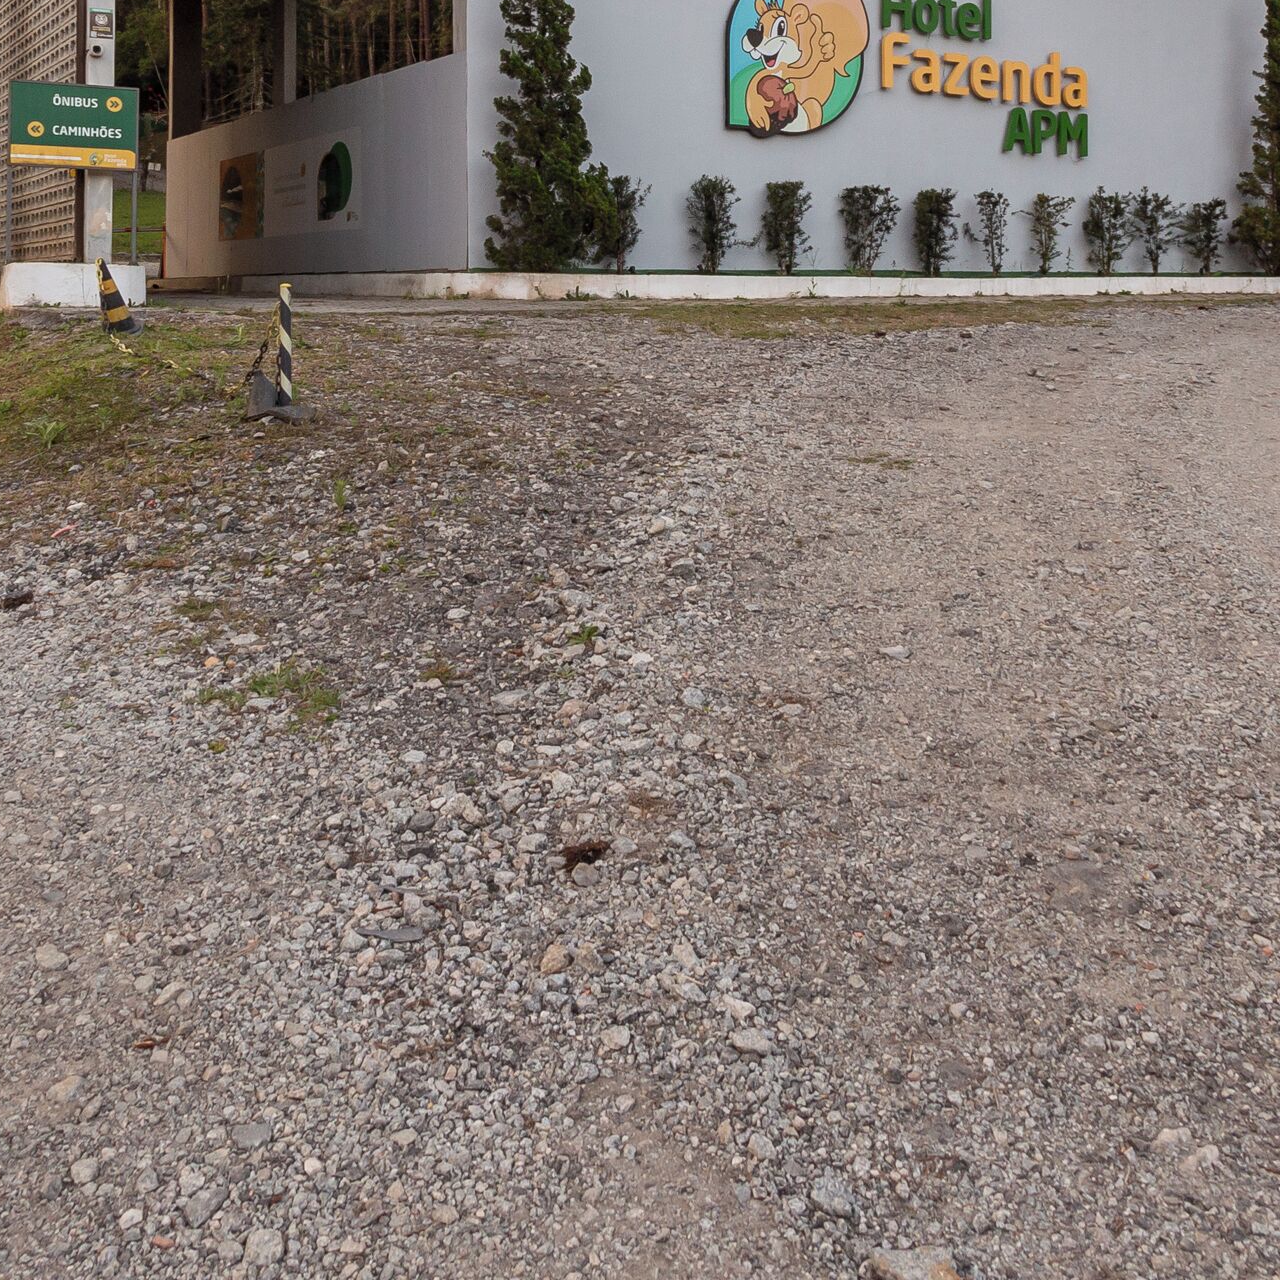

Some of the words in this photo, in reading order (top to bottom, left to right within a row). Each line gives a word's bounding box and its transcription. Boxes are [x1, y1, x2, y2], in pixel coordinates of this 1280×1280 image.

[881, 31, 1089, 108] Fazenda
[52, 93, 99, 109] ÔNIBUS
[52, 125, 123, 139] CAMINHÕES
[1002, 106, 1089, 158] APM
